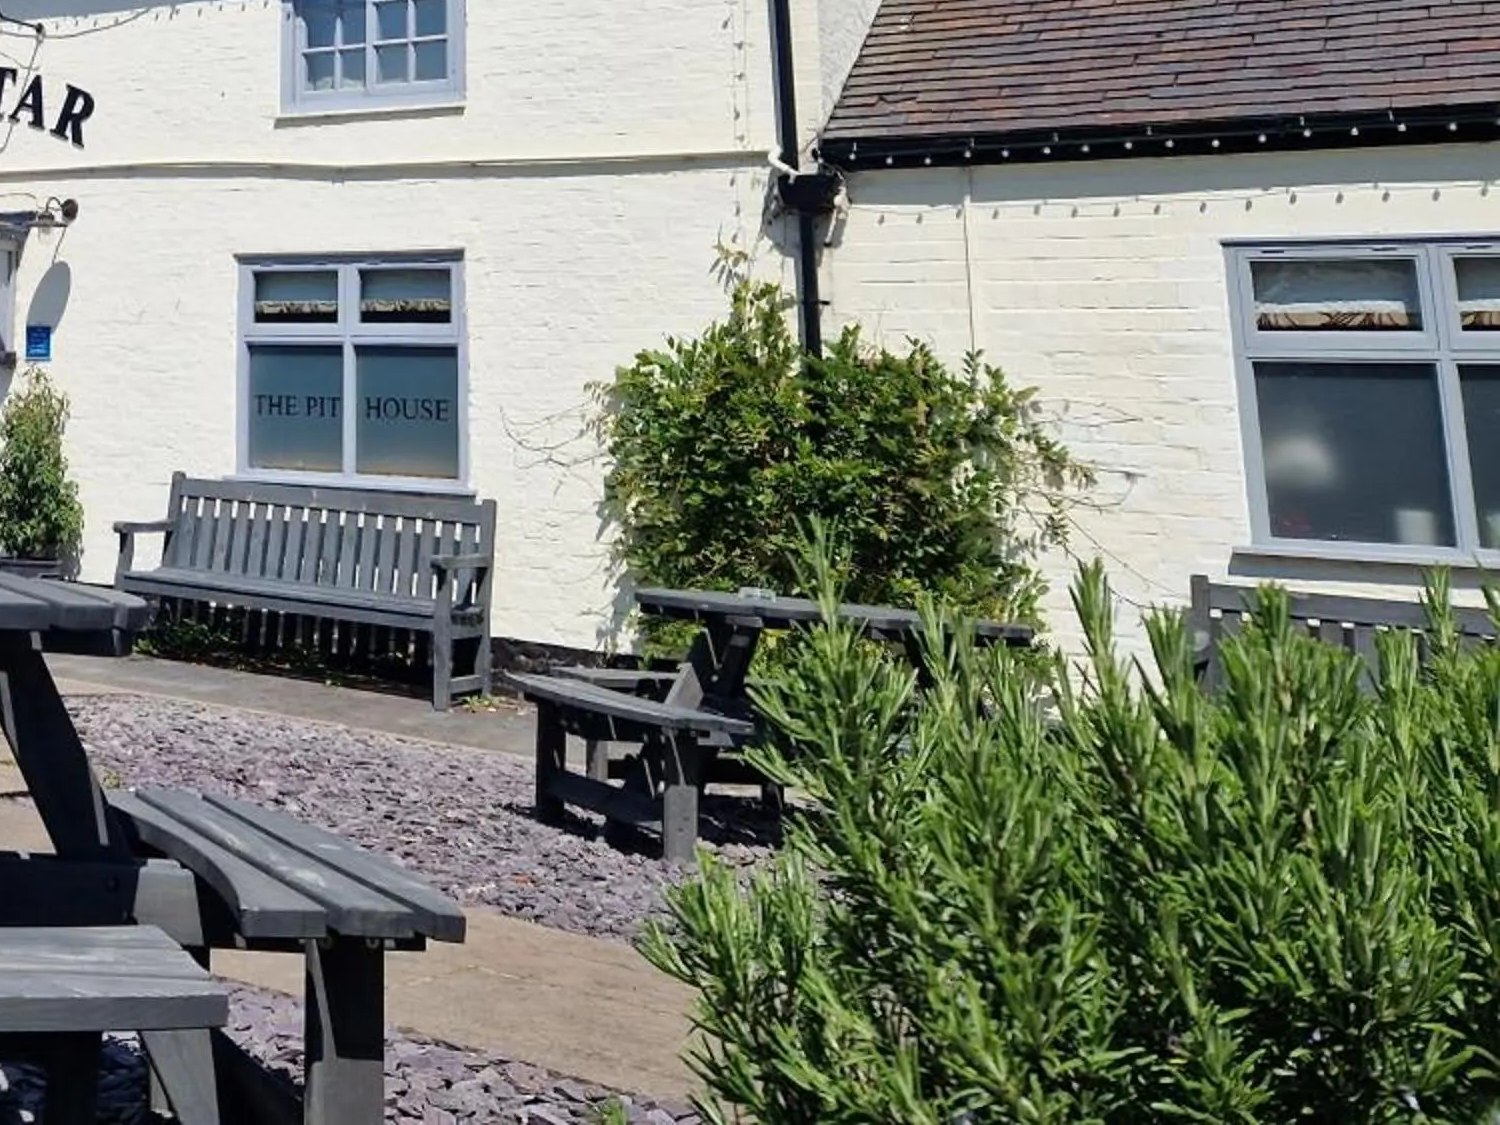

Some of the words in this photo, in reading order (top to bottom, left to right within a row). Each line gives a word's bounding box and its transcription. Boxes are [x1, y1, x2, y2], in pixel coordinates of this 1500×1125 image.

[254, 393, 298, 417] THE
[305, 395, 341, 419] PIT
[365, 396, 450, 422] HOUSE
